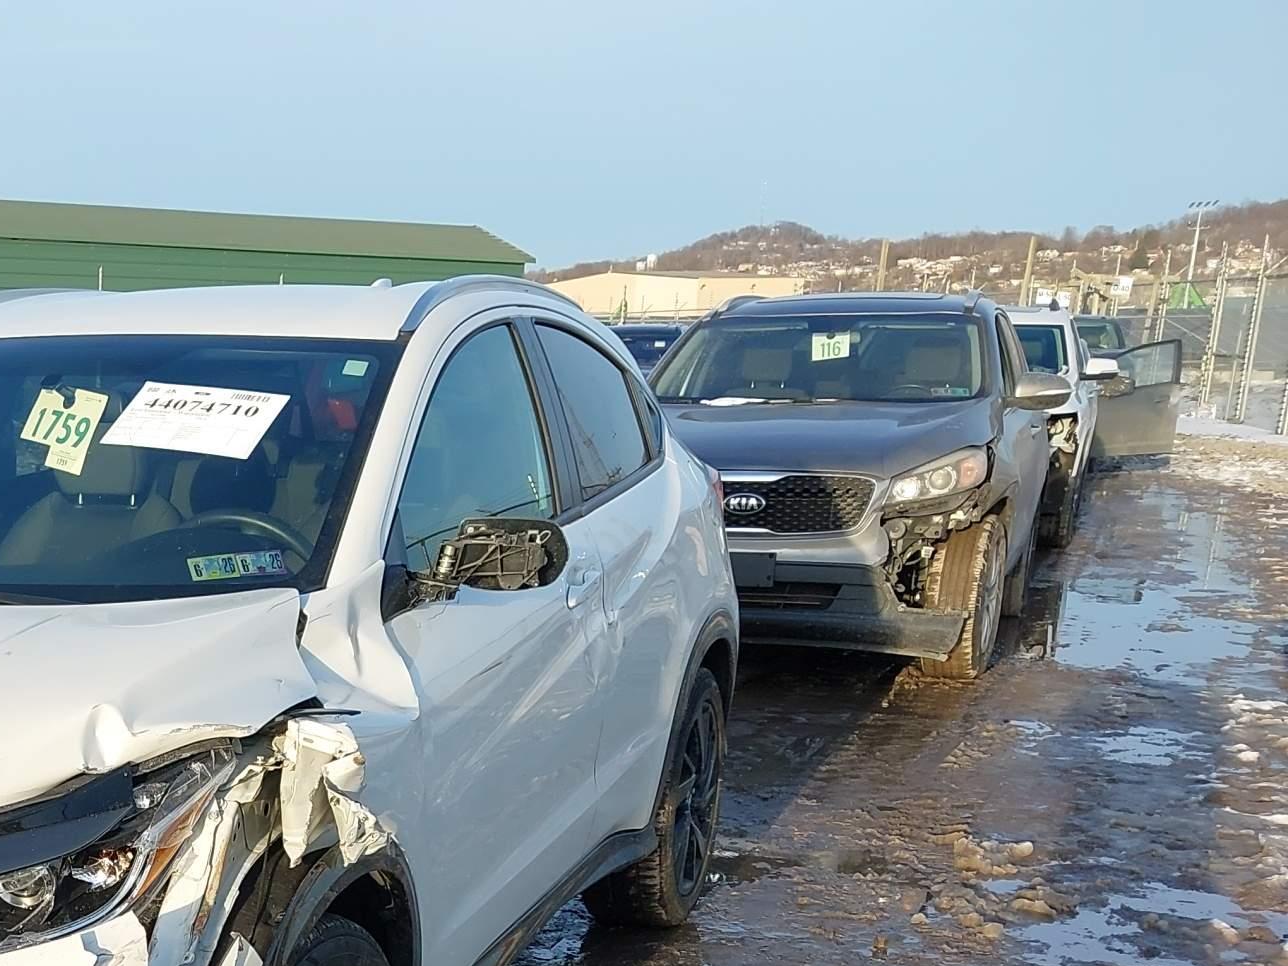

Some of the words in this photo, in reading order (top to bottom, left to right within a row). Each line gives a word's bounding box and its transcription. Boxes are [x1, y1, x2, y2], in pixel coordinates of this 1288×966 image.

[820, 340, 841, 358] 116
[144, 398, 260, 418] 44074710
[31, 408, 91, 448] 1759
[729, 497, 758, 510] KIA
[221, 557, 236, 574] 26
[268, 553, 283, 570] 26
